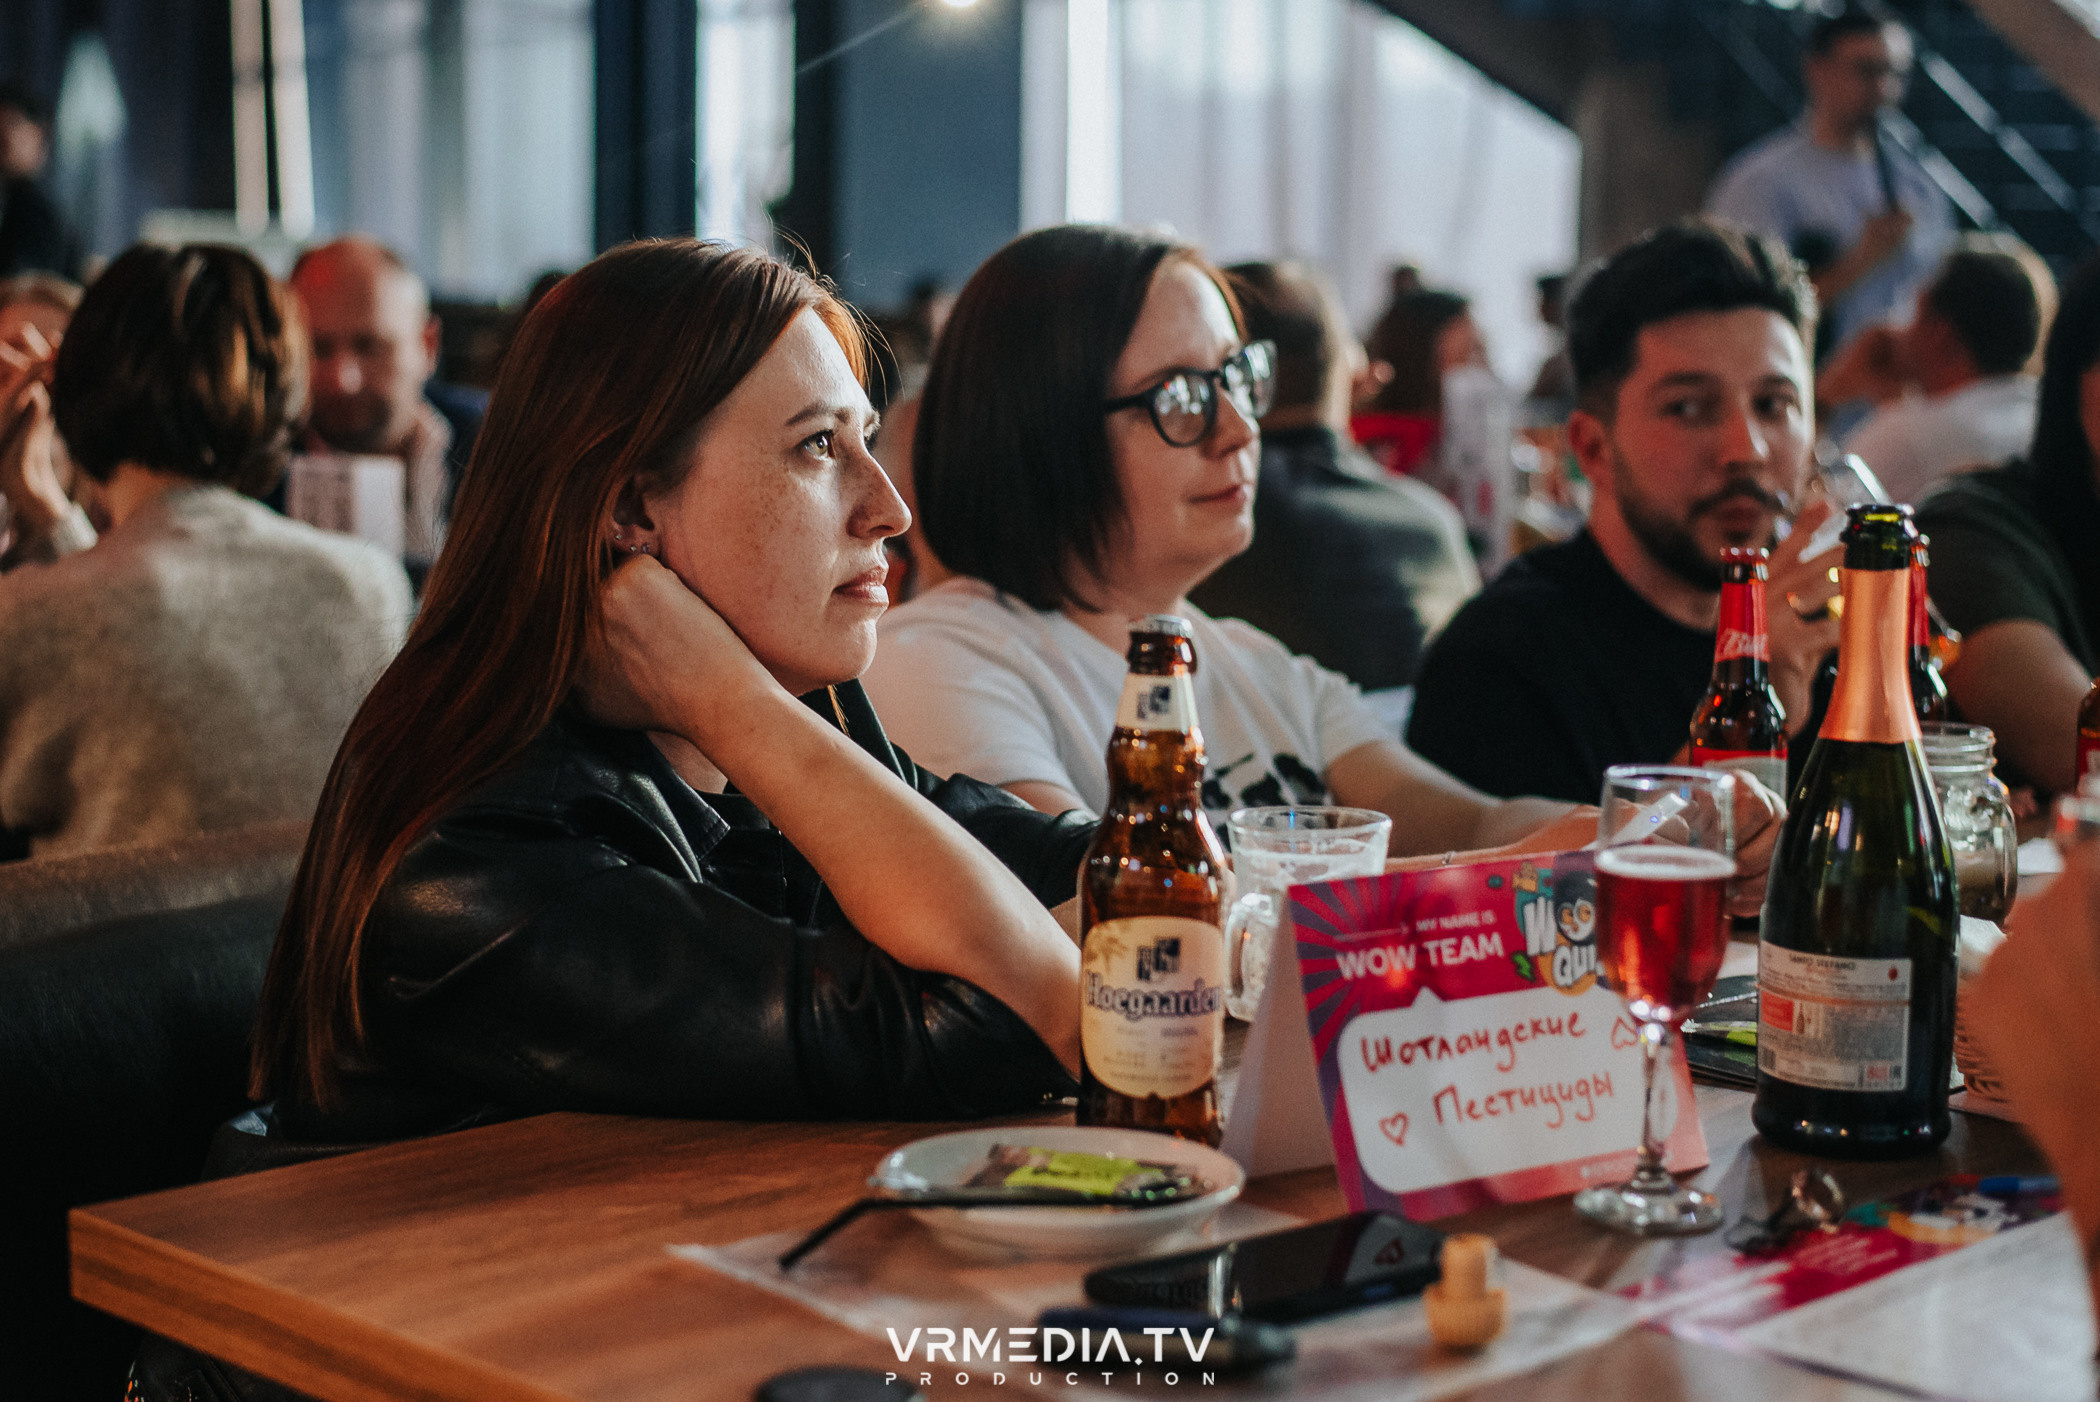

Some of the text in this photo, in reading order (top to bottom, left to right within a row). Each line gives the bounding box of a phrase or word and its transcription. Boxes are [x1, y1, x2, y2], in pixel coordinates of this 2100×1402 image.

[1416, 909, 1496, 932] MY NAME IS
[1336, 931, 1504, 980] WOW TEAM
[1553, 944, 1605, 987] QUI
[1361, 1012, 1586, 1072] Шотландские
[1433, 1072, 1614, 1129] Пестициды
